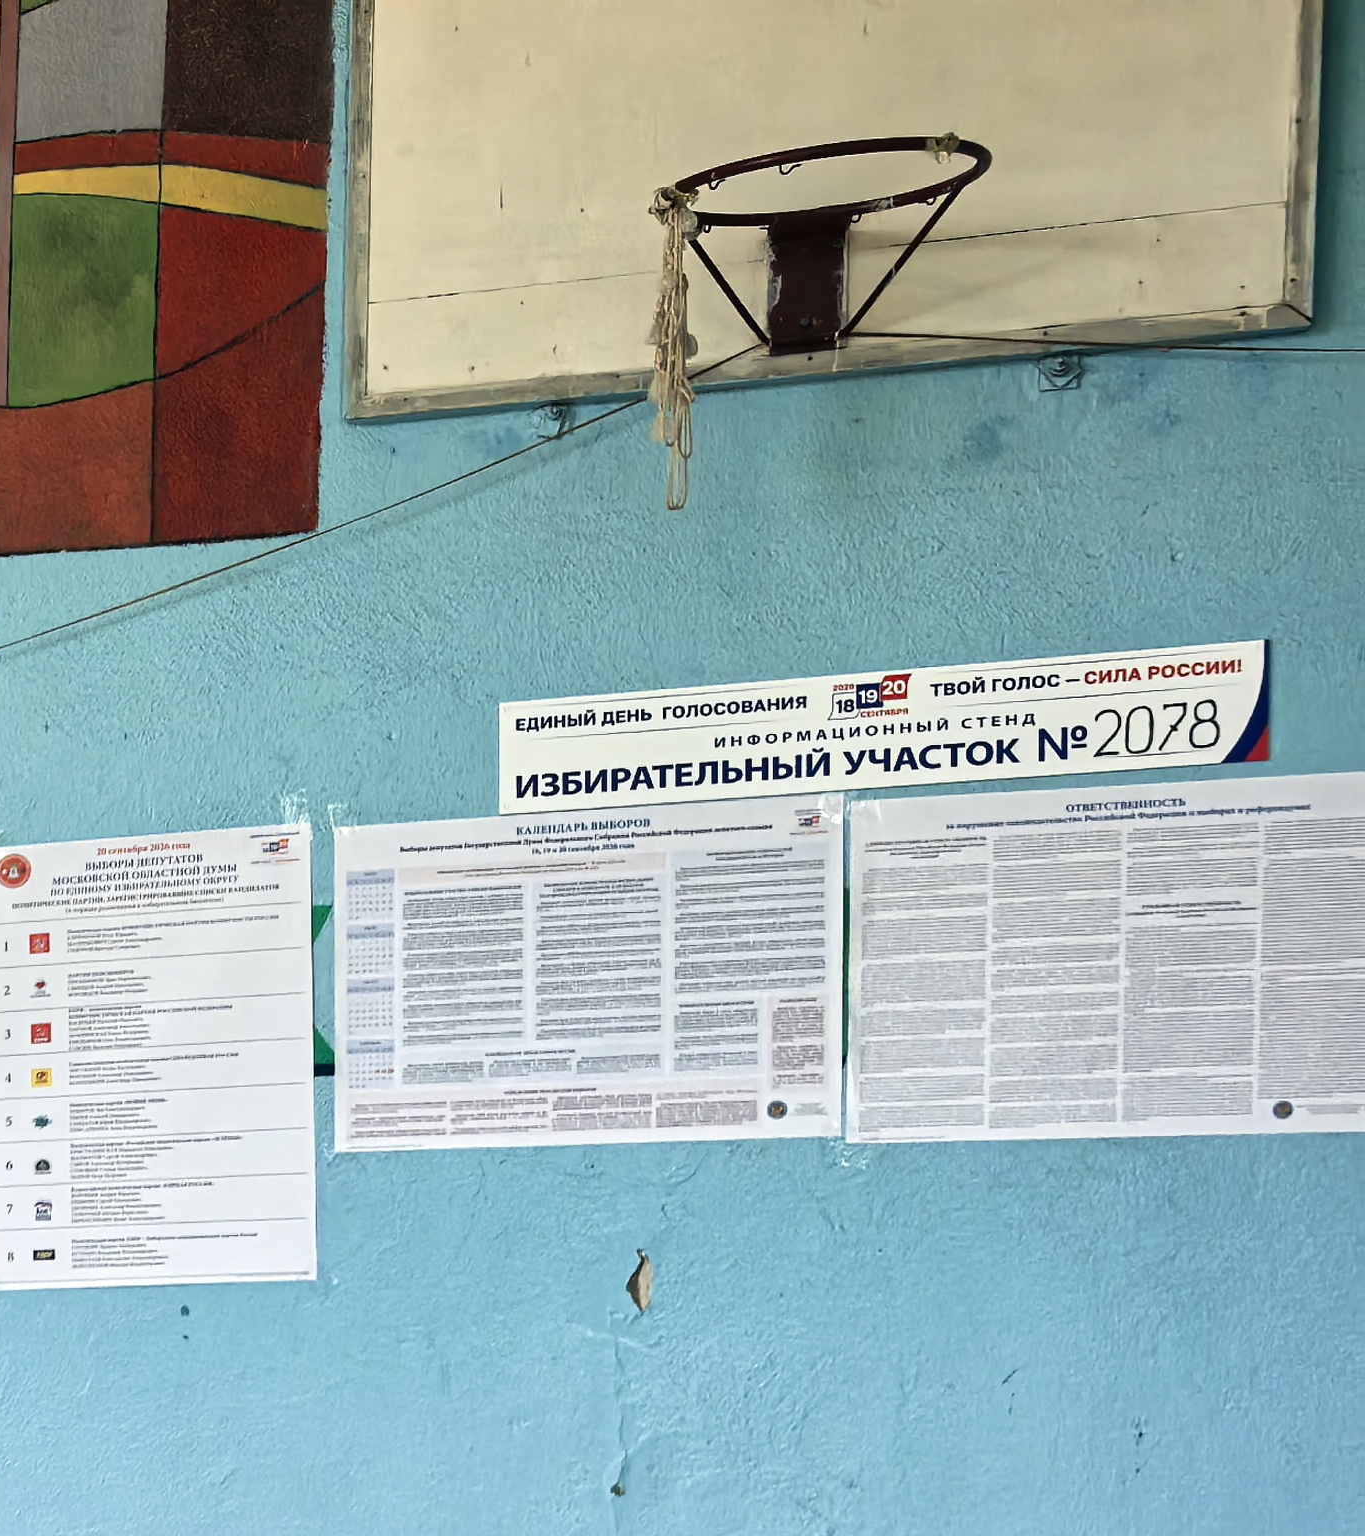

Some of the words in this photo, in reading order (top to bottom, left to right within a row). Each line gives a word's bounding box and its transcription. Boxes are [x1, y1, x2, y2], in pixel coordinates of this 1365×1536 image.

[930, 675, 986, 698] ТВОЙ
[992, 673, 1061, 693] ГОЛОС
[1084, 667, 1142, 686] СИЛА
[1148, 659, 1244, 682] РОССИИ!
[515, 709, 597, 732] ЕДИНЫЙ
[601, 707, 652, 727] ДЕНЬ
[662, 695, 808, 720] ГОЛОСОВАНИЯ
[835, 699, 855, 714] 18
[858, 689, 878, 704] 19
[882, 680, 907, 695] 20
[713, 718, 949, 748] ИНФОРМАЦИОННЫЙ
[961, 713, 1037, 731] СТЕНД
[515, 750, 831, 798] ИЗБИРАТЕЛЬНЫЙ
[843, 739, 1020, 776] УЧАСТОК
[1038, 724, 1089, 763] №
[1092, 698, 1221, 759] 2078
[516, 821, 588, 837] КАЛЕНДАРЬ
[590, 818, 651, 832] ВЫБОРОВ
[52, 871, 129, 886] МОСКОВСКОЙ
[203, 863, 238, 877] ДУМЫ
[85, 858, 134, 872] ВЫБОРЫ
[136, 853, 204, 869] ДЕПУТАТОВ
